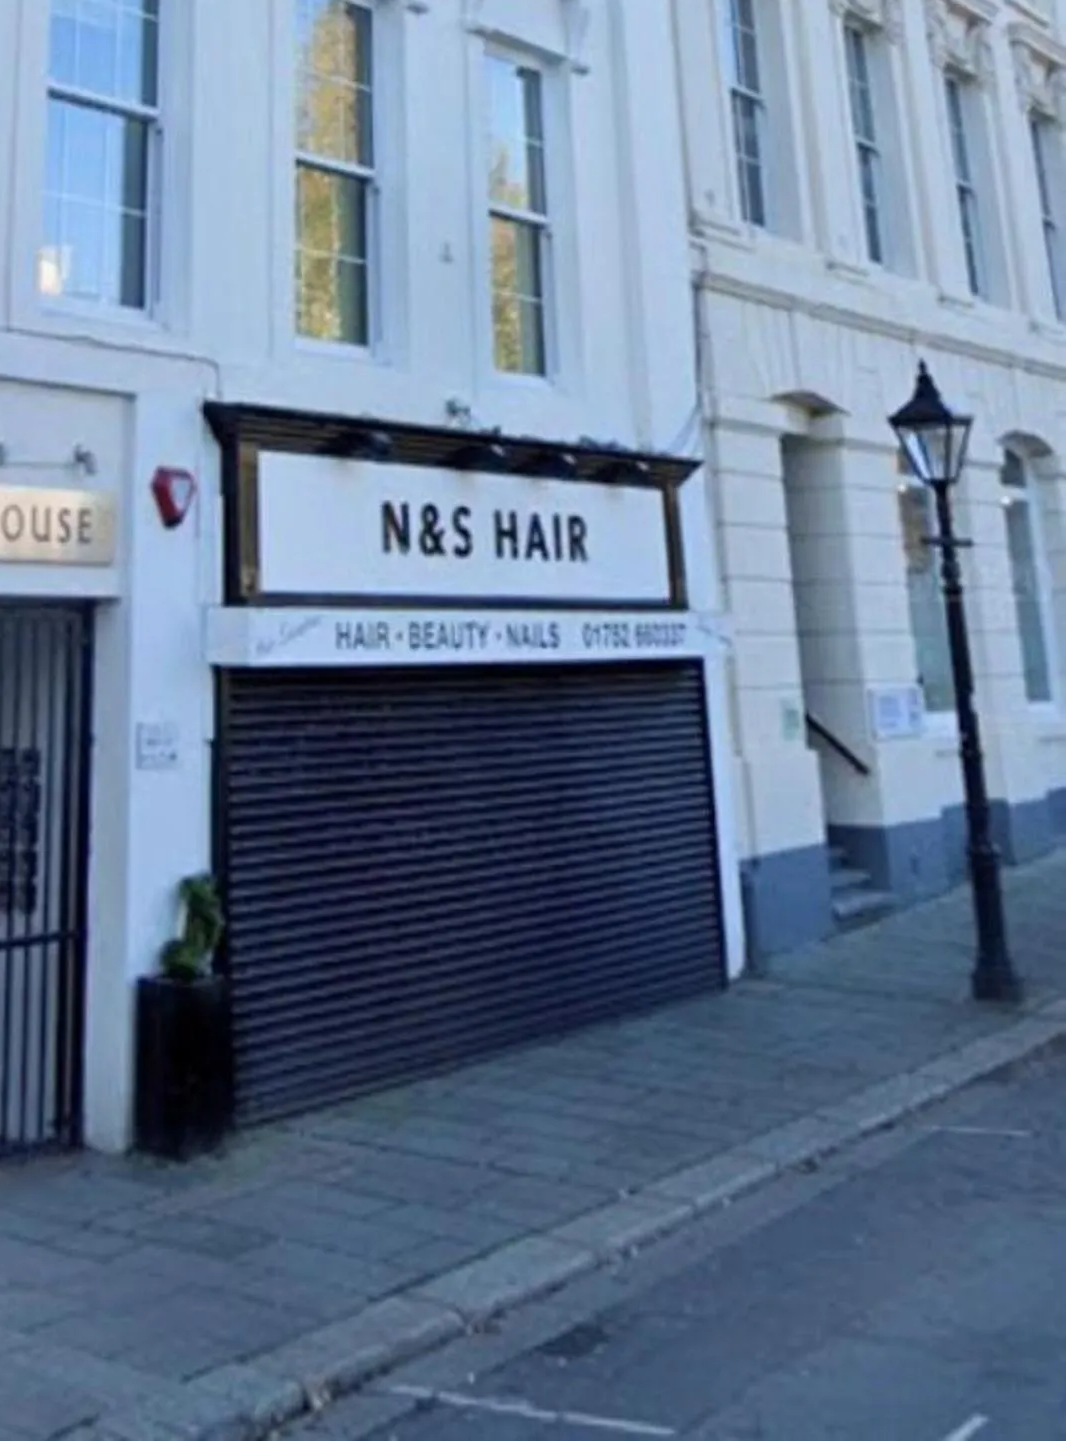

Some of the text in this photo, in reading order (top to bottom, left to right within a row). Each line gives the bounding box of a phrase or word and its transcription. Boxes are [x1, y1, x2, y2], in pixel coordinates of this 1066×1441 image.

[381, 499, 590, 562] N&S HAIR
[334, 620, 391, 650] HAIR
[408, 620, 491, 651] BEAUTY
[505, 620, 561, 650] NAILS
